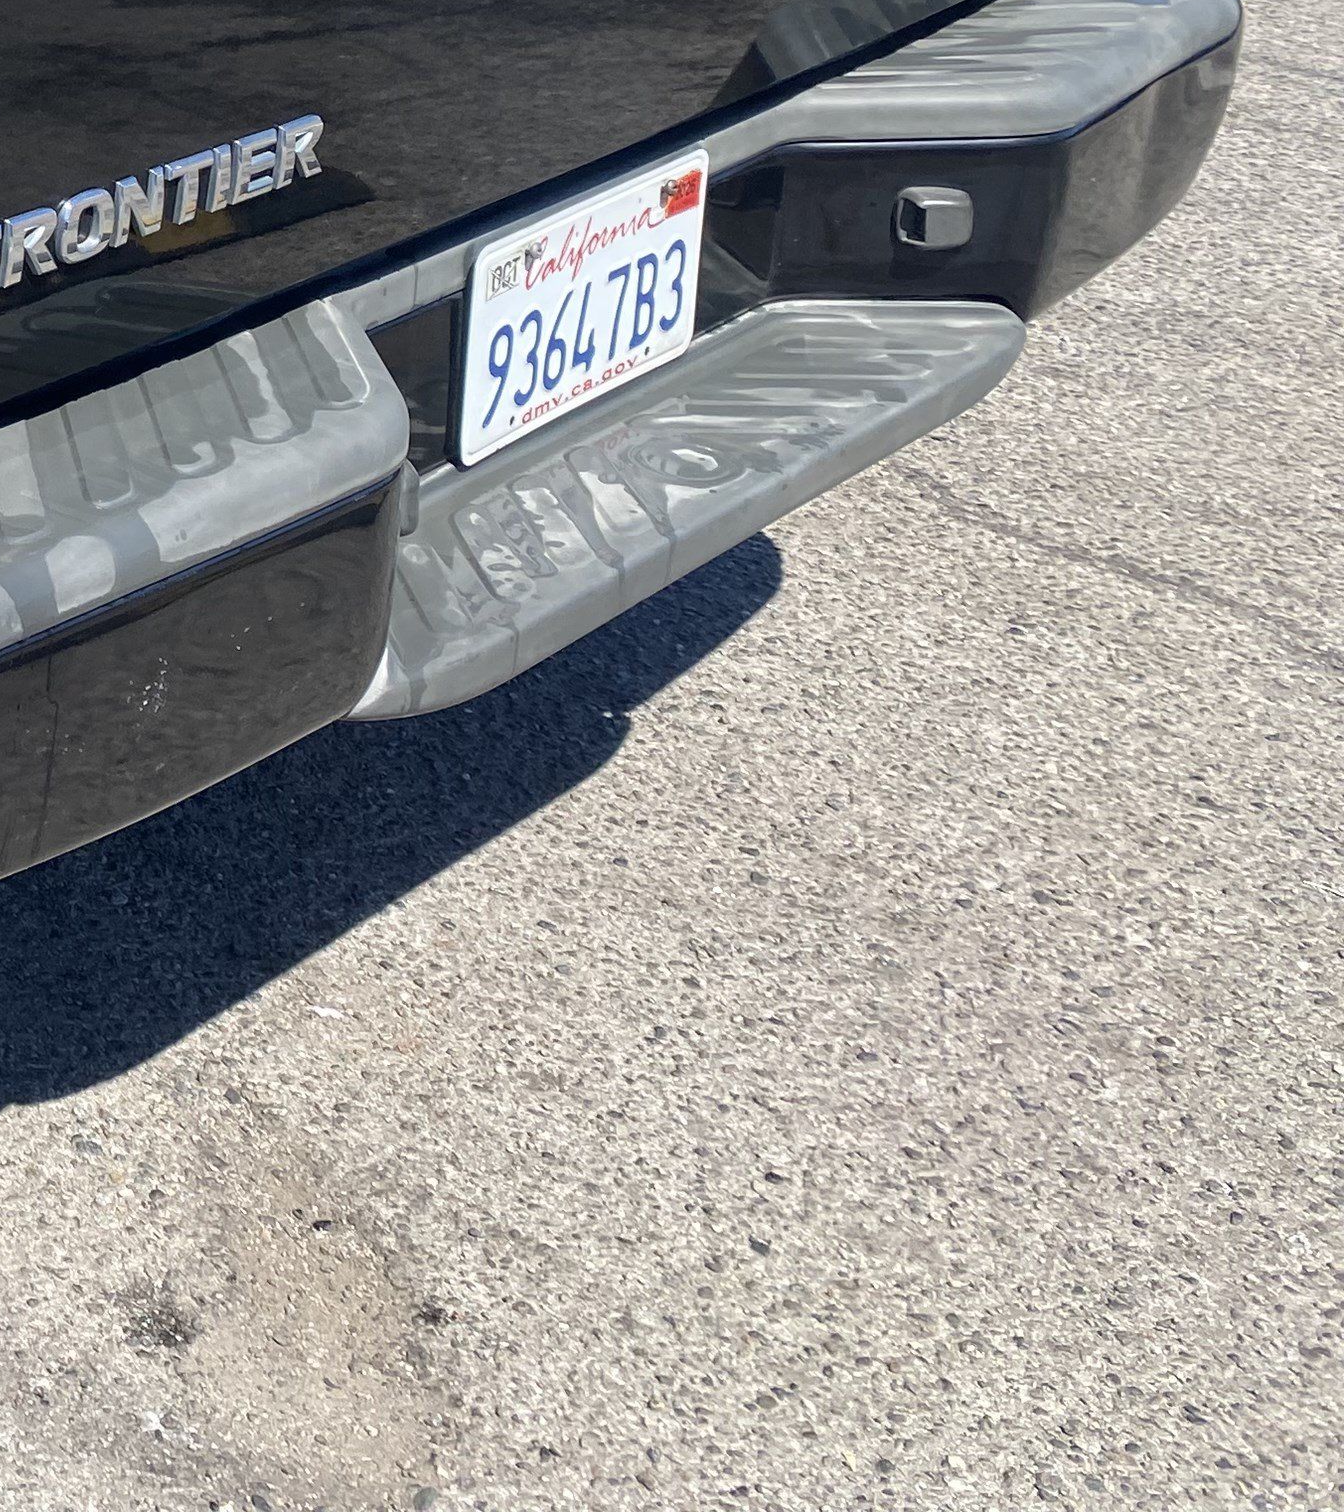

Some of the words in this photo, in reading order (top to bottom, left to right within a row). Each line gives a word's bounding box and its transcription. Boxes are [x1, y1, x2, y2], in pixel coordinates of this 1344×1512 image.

[524, 204, 667, 291] California
[481, 238, 687, 429] 93647B3
[521, 355, 639, 425] dmv.ca.gov
